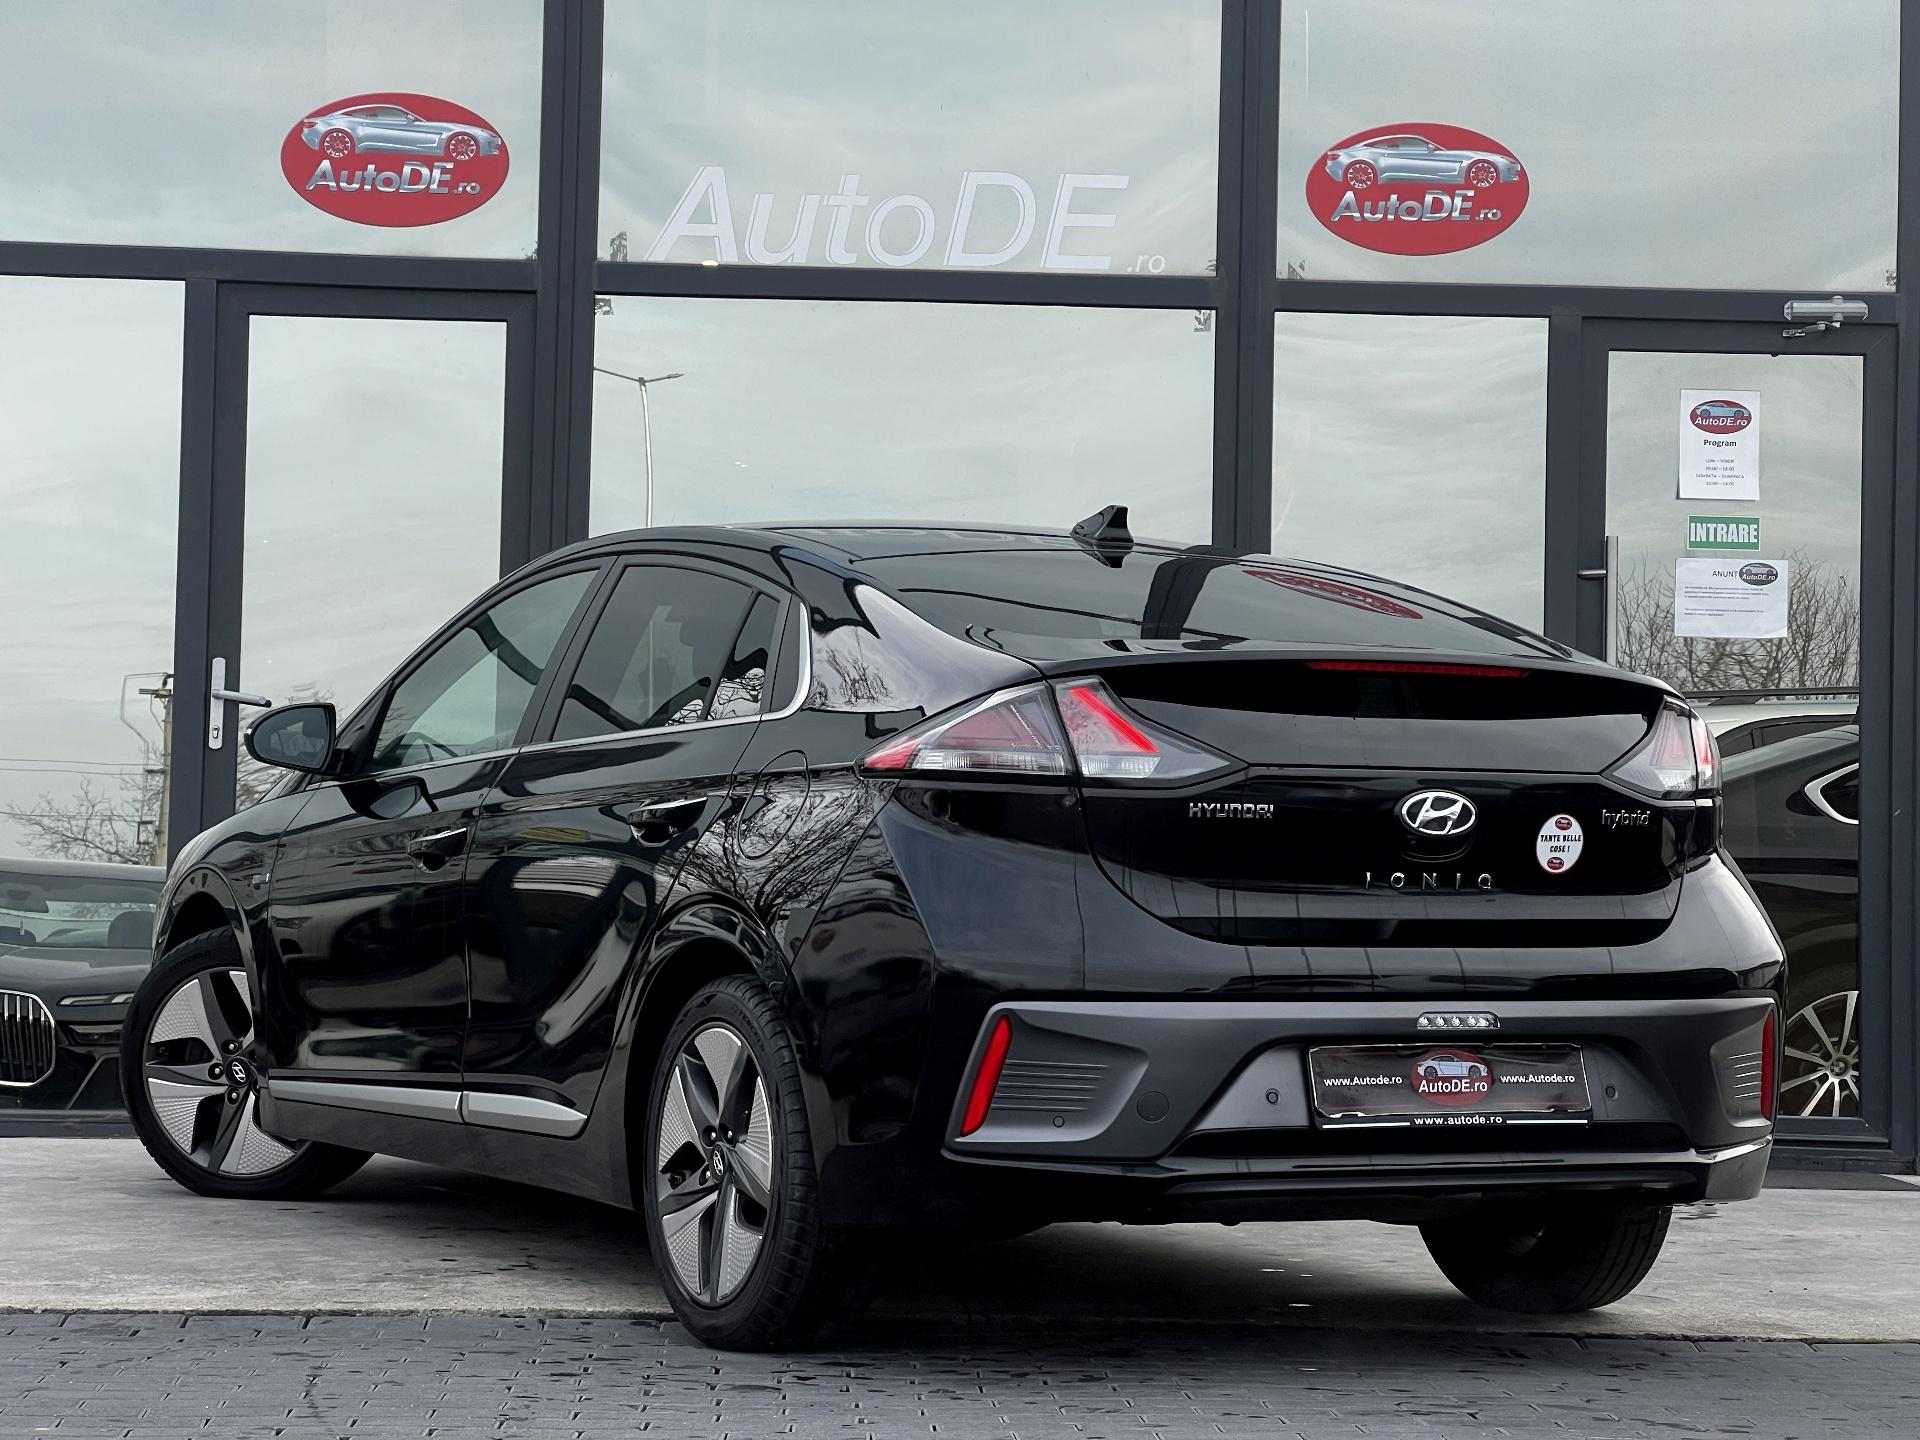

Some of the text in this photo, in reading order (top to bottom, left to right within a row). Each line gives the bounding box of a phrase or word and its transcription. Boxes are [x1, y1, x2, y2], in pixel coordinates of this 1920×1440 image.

[1703, 439, 1737, 447] Program
[1690, 522, 1758, 542] INTRARE
[1189, 802, 1274, 819] HYUNDAI
[1601, 809, 1651, 830] hybrid
[1540, 834, 1582, 842] TANTE BELLE
[1365, 871, 1493, 891] IONIQ
[1323, 1074, 1403, 1087] www.Autode.ro
[1418, 1078, 1489, 1093] AutoDE.ro
[1500, 1073, 1576, 1084] www.Autode.ro
[1413, 1114, 1503, 1126] www.autode.ro
